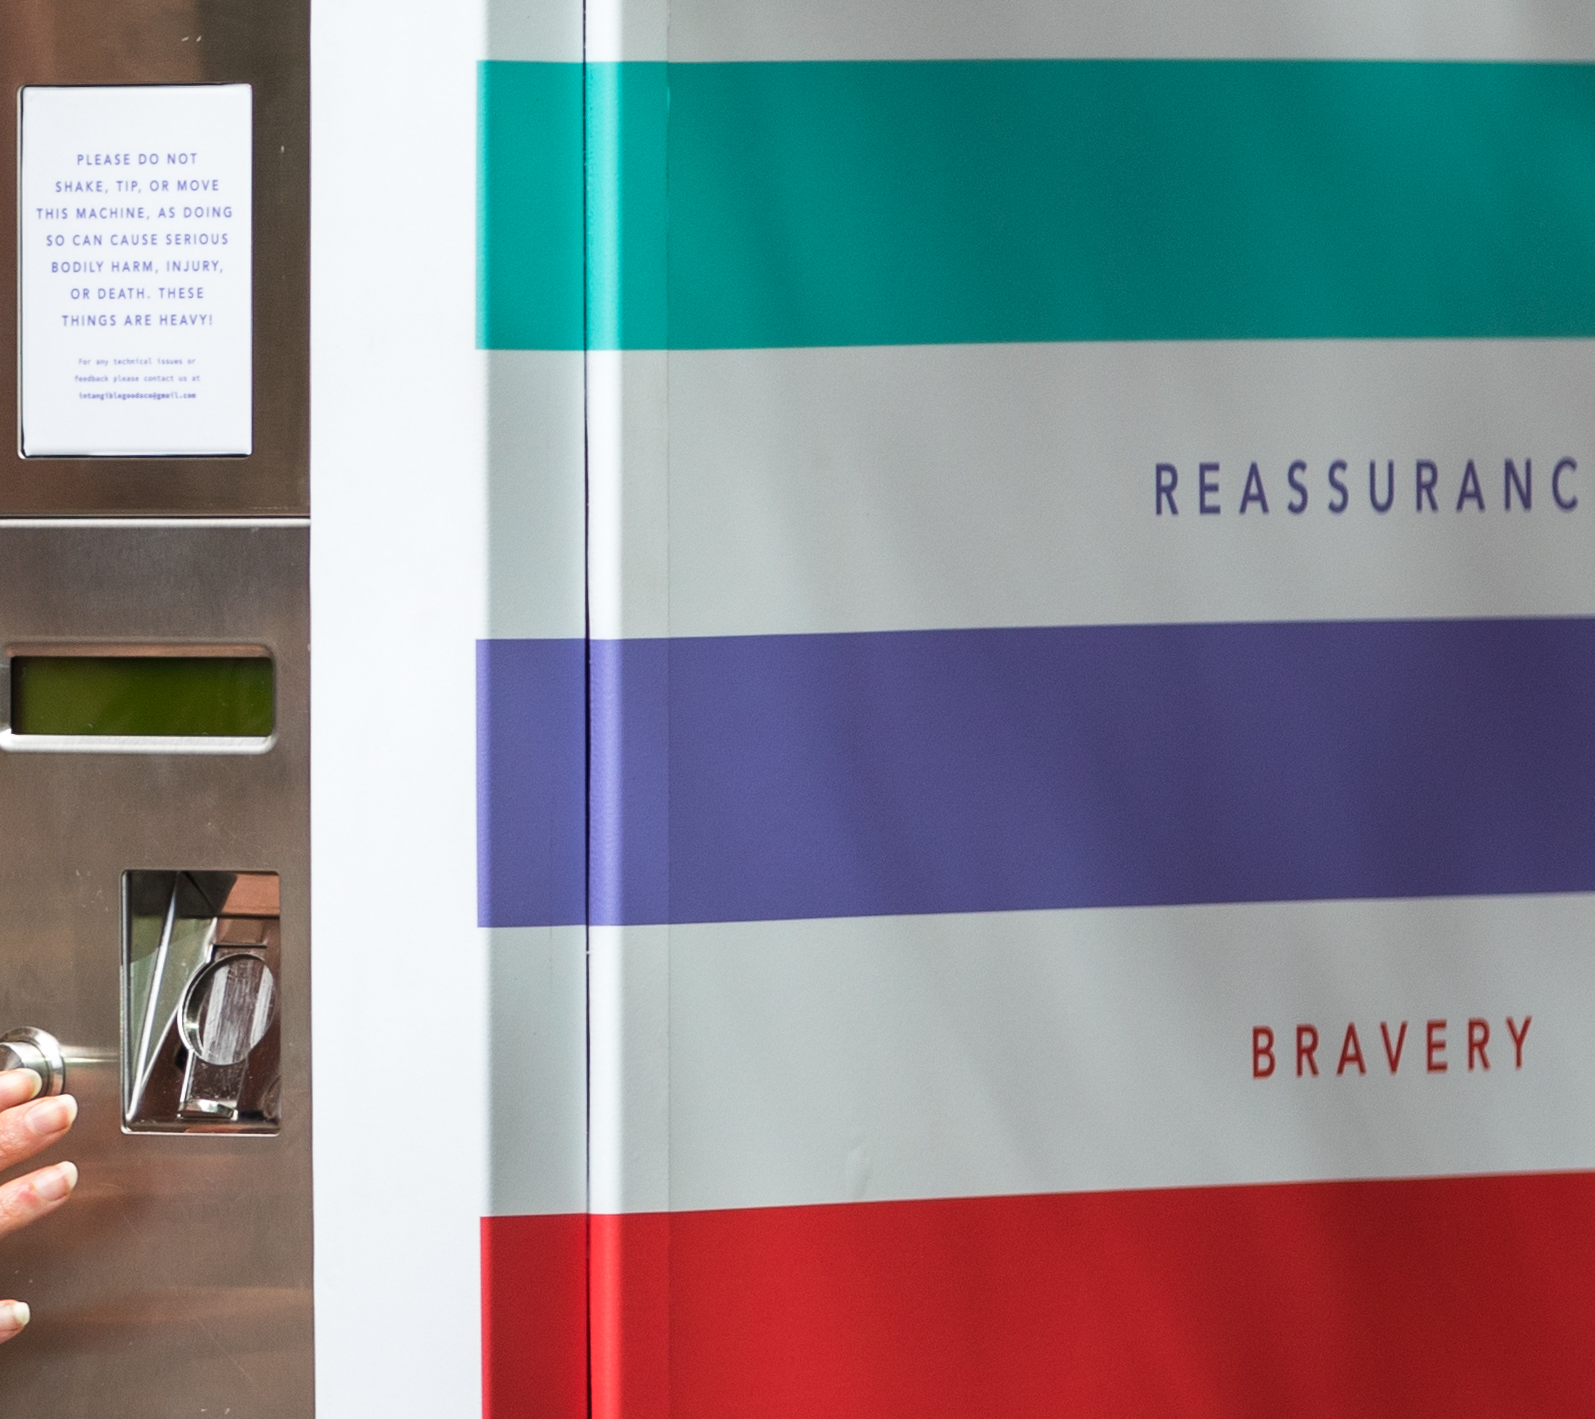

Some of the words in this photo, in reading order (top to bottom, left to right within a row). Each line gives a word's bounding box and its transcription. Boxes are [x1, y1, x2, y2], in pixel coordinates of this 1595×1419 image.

[76, 153, 131, 166] PLEASE
[138, 153, 160, 166] DO
[166, 152, 198, 165] NOT
[55, 180, 109, 194] SHAKE,
[115, 180, 142, 193] TIP,
[149, 179, 169, 192] OR
[176, 178, 219, 192] MOVE
[35, 208, 69, 220] THIS
[75, 206, 150, 220] MACHINE,
[157, 206, 176, 219] AS
[183, 205, 233, 219] DOING
[45, 234, 66, 247] SO
[72, 234, 103, 247] CAN
[109, 234, 158, 246] CAUSE
[165, 232, 229, 245] SERIOUS
[50, 260, 104, 274] BODILY
[111, 260, 159, 274] HARM,
[166, 260, 223, 274] INJURY,
[70, 287, 90, 300] OR
[97, 287, 151, 300] DEATH.
[158, 287, 204, 300] THESE
[61, 314, 117, 327] THINGS
[123, 314, 152, 326] ARE
[159, 314, 213, 326] HEAVY!
[78, 357, 91, 365] For
[113, 357, 153, 365] technical
[74, 375, 109, 383] feedback
[112, 375, 140, 384] please
[1251, 1016, 1533, 1079] BRAVERY
